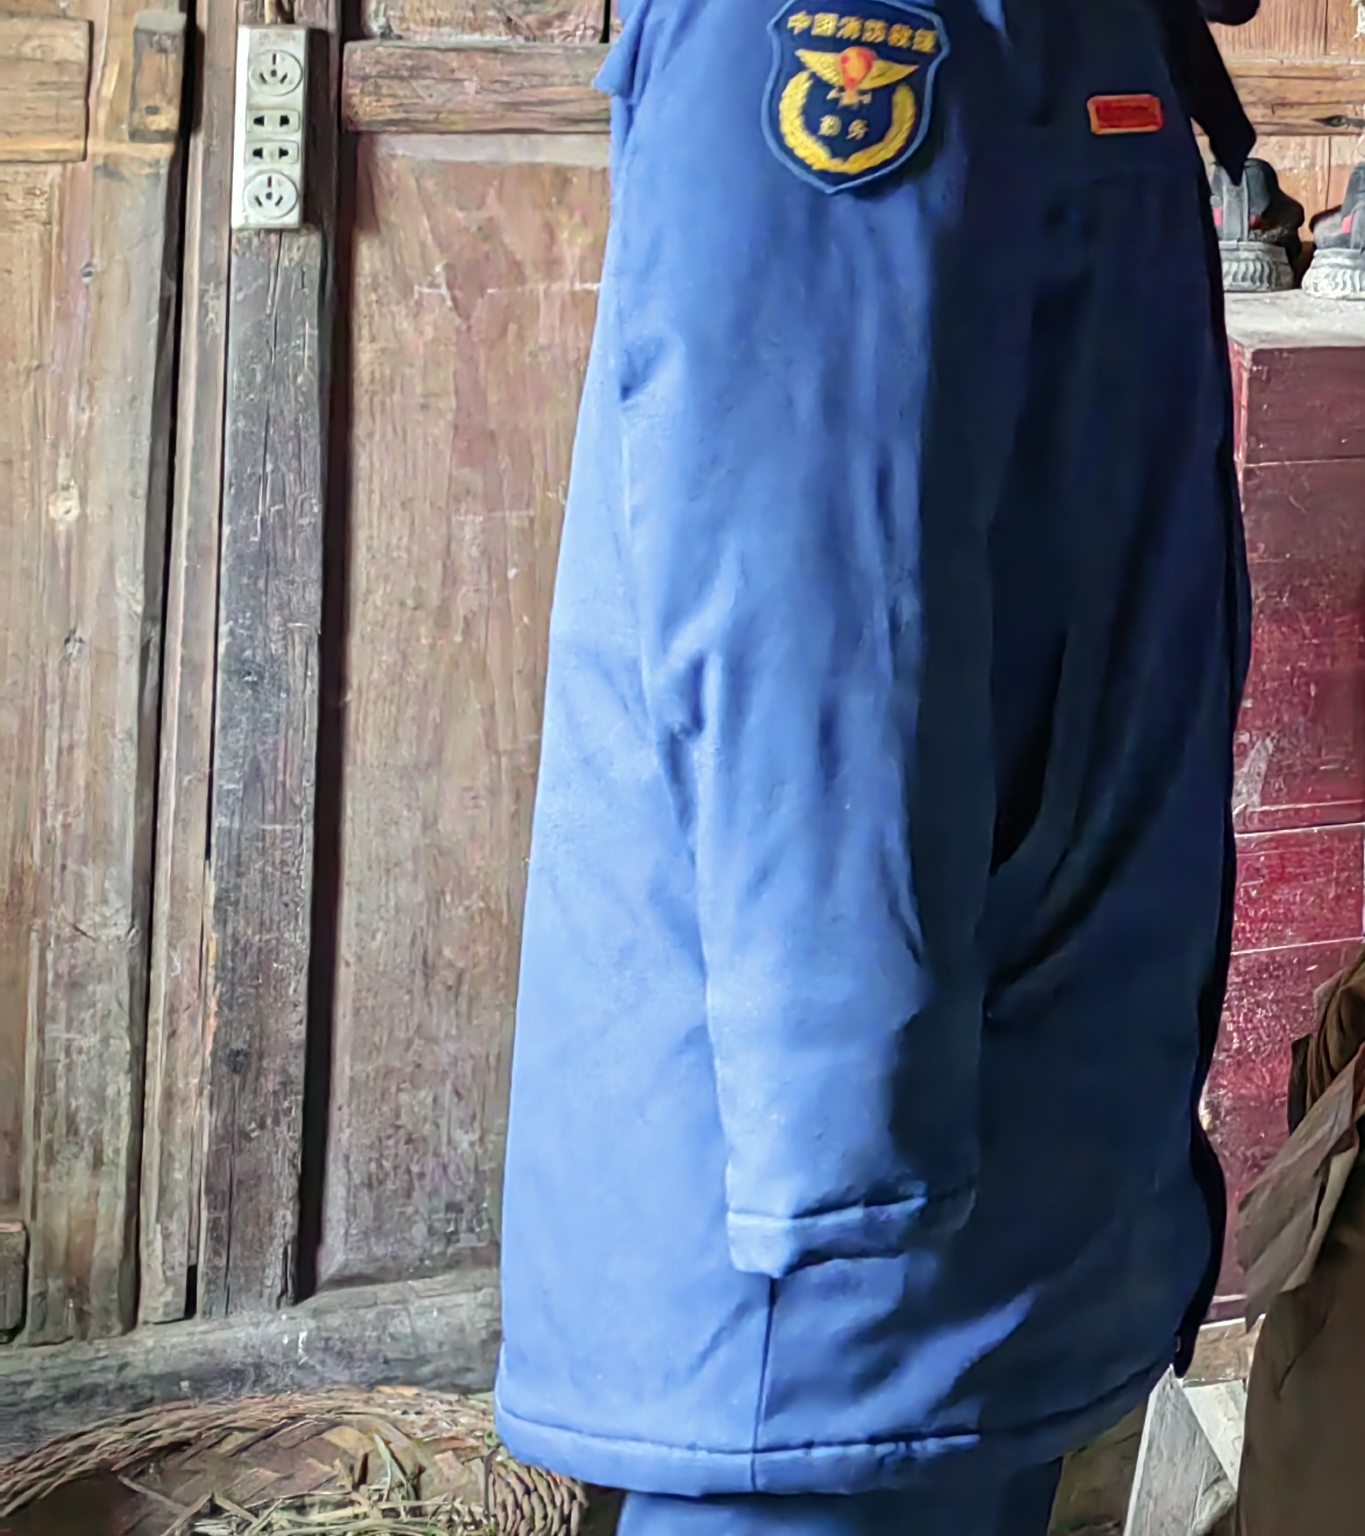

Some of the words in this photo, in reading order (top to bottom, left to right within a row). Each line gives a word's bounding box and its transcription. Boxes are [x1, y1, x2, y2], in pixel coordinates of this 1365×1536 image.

[787, 10, 938, 54] 中国消防救援
